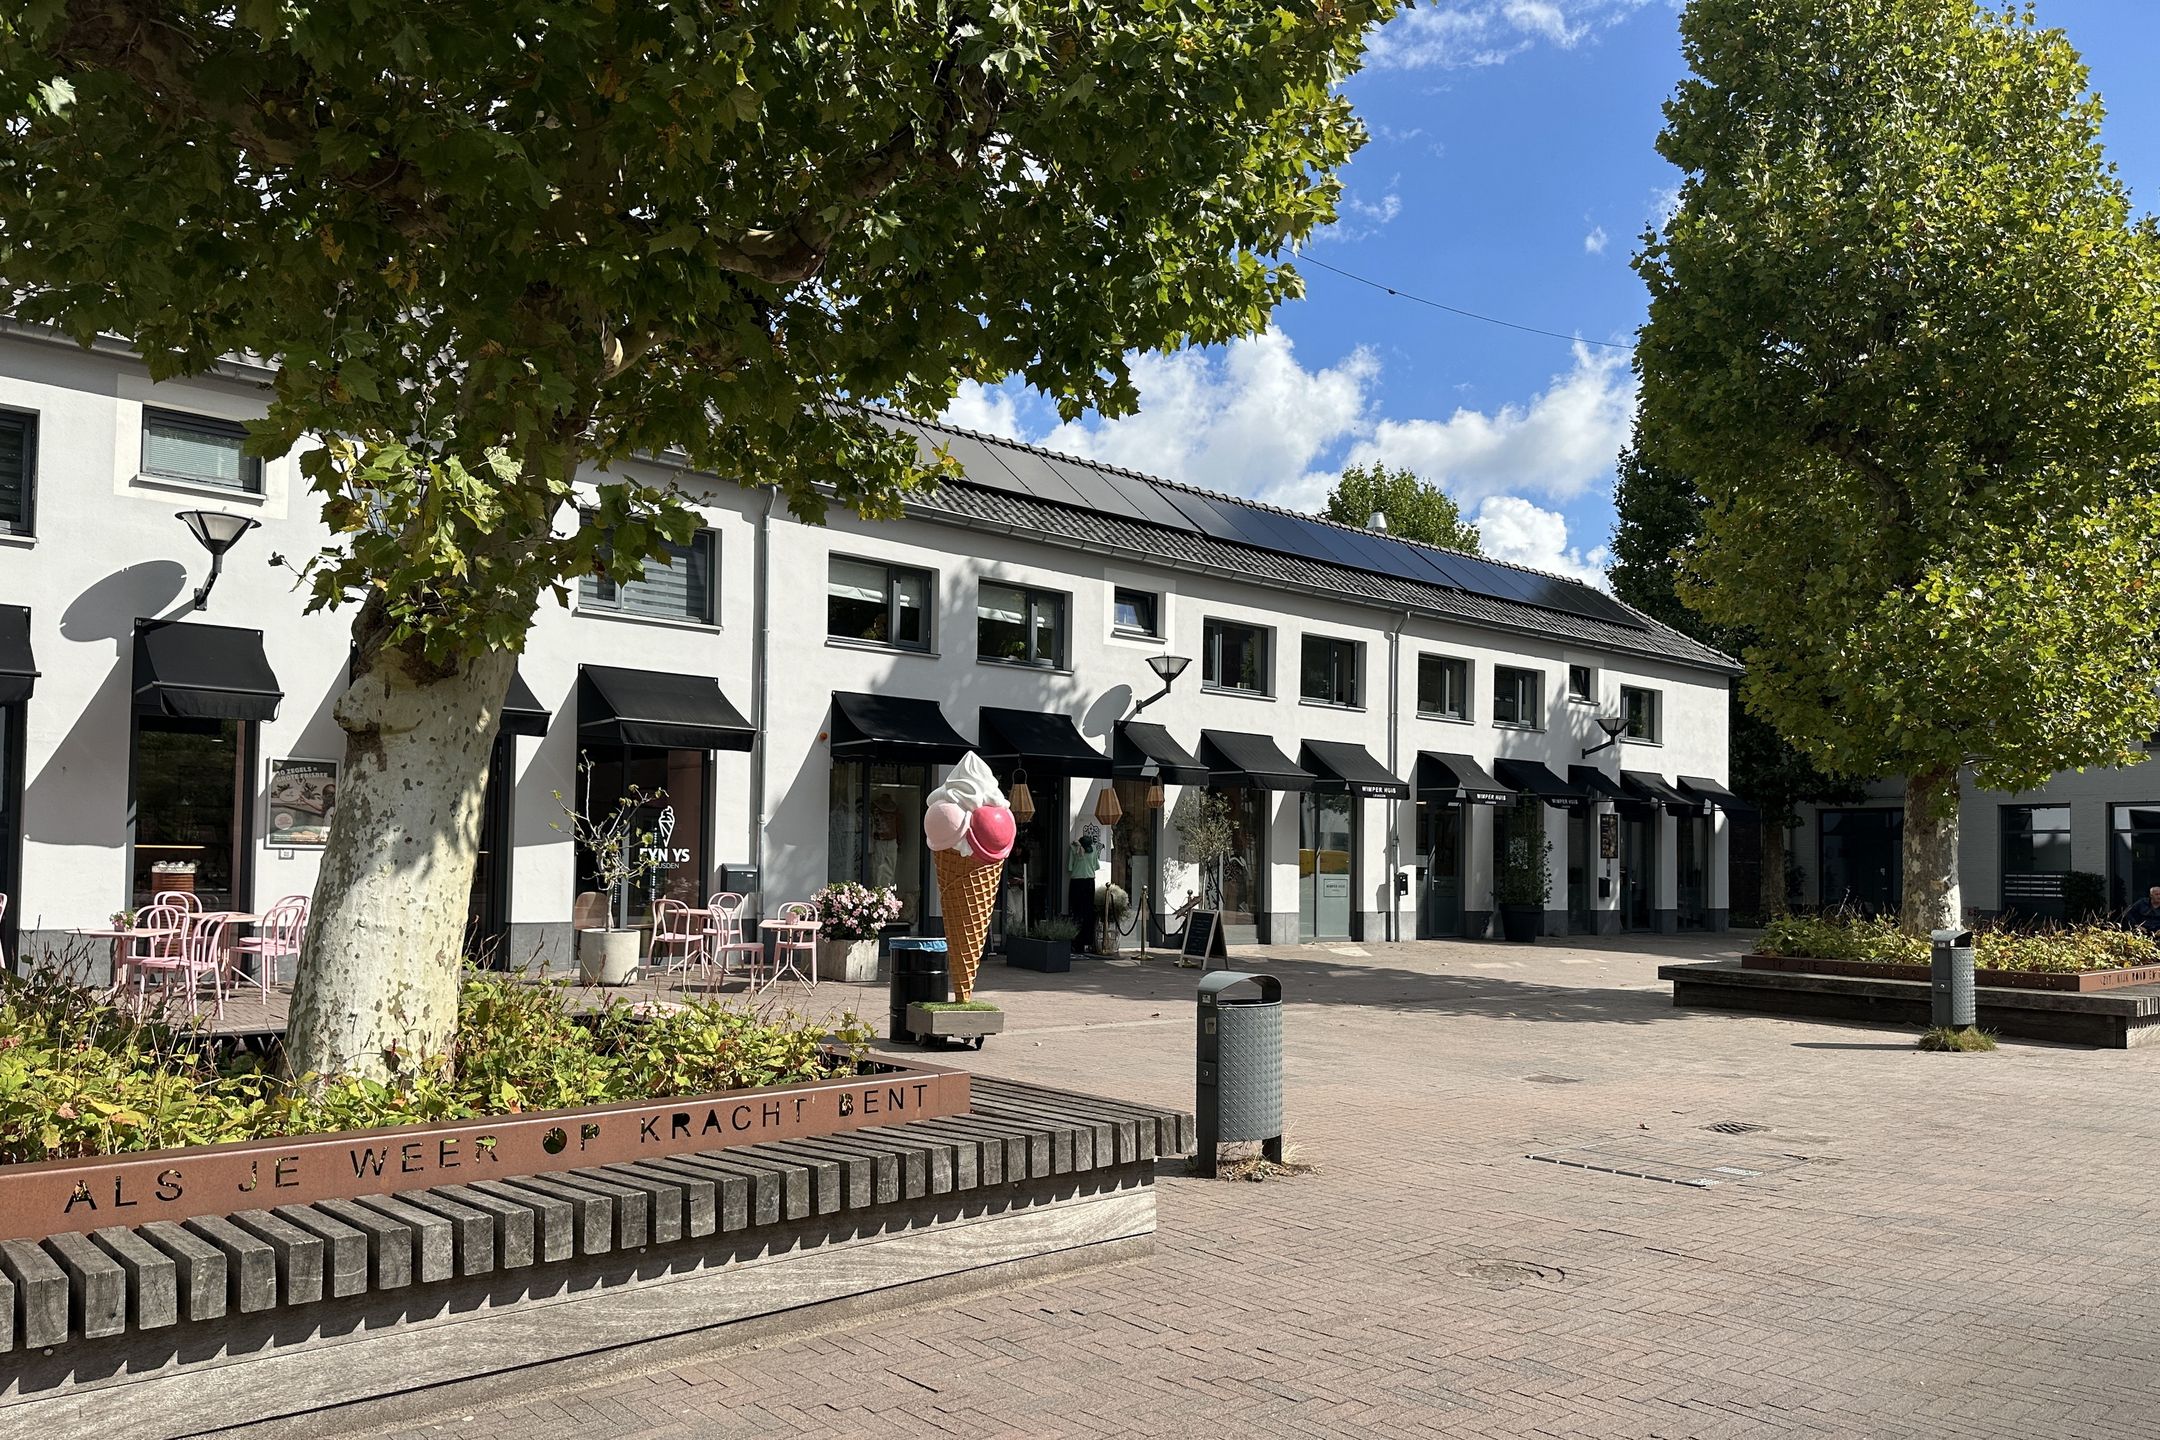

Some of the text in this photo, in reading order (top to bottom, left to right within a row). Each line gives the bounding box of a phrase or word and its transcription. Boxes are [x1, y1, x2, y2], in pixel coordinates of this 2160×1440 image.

[286, 766, 312, 775] ZEGELS
[1361, 785, 1383, 793] WIMPER
[672, 848, 690, 863] YS
[64, 1084, 928, 1213] ALS JE WEER OP KRACHT BENT
